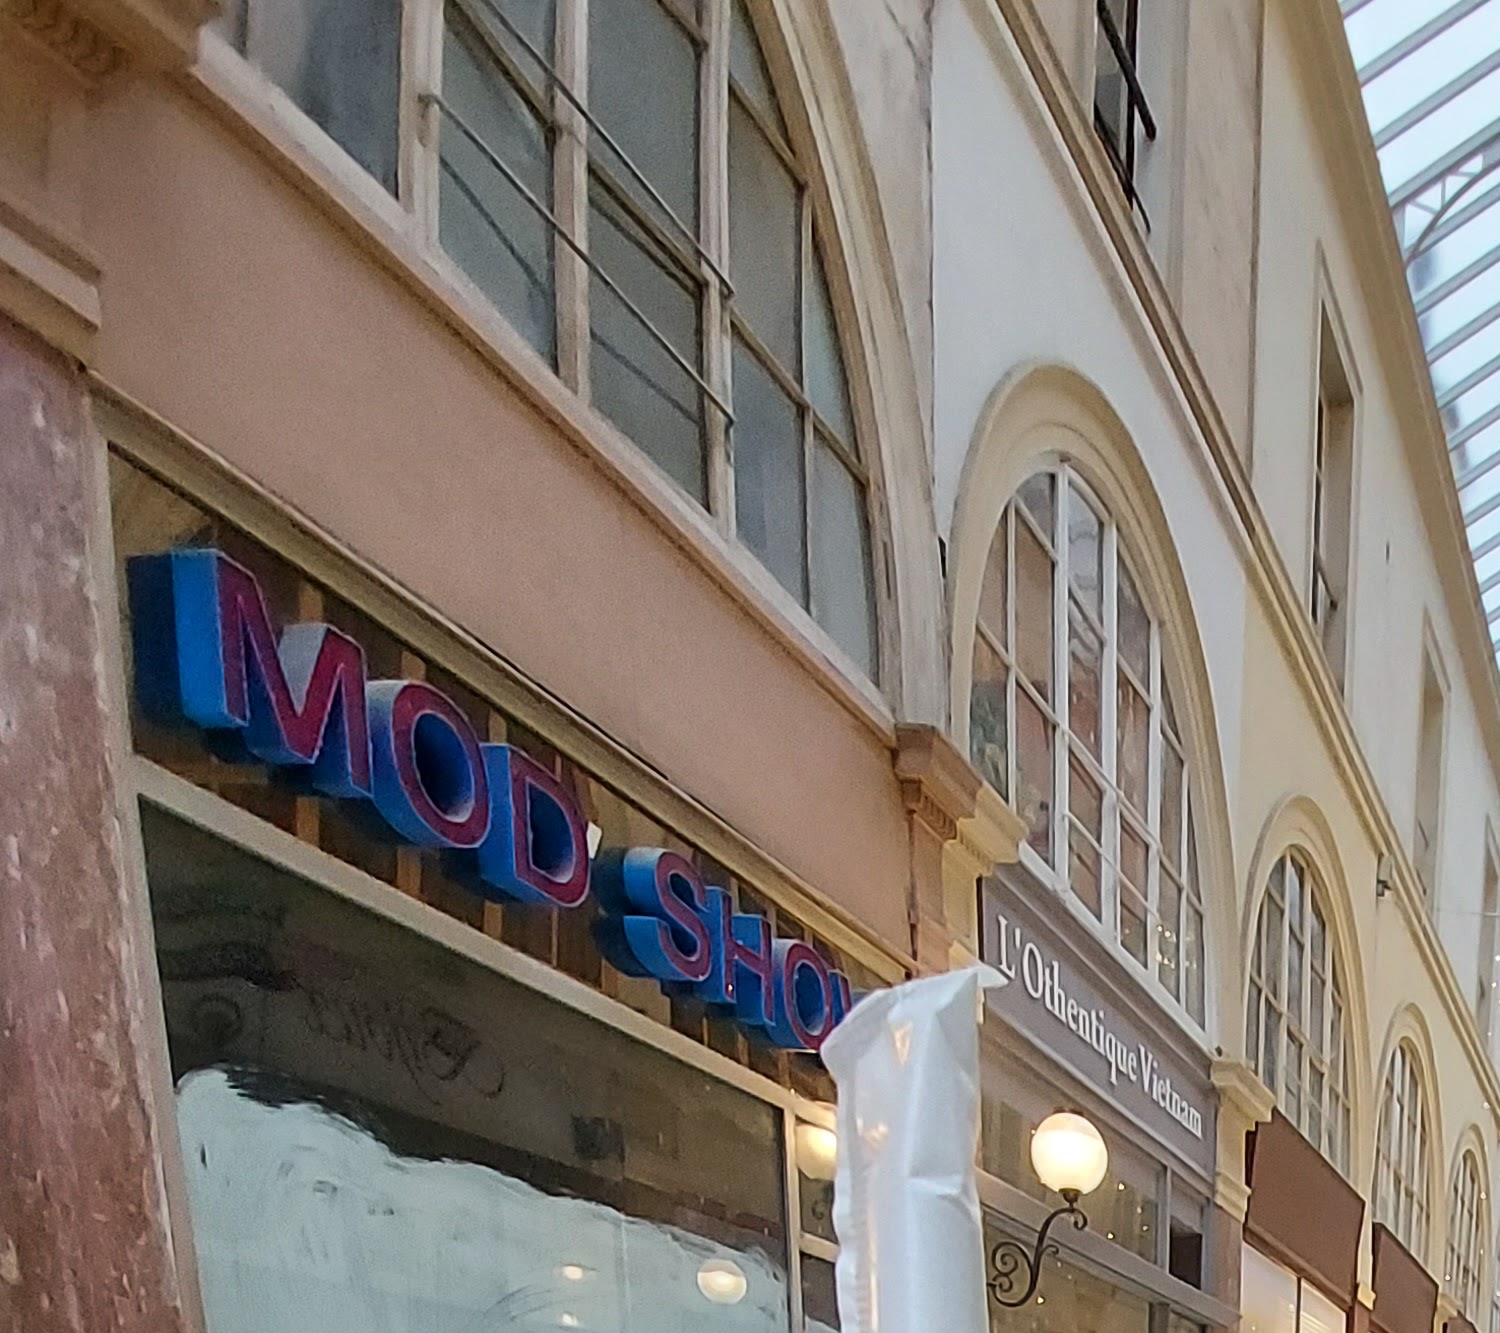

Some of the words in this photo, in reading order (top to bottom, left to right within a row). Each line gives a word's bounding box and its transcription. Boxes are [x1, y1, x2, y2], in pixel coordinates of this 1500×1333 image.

[172, 548, 590, 908] MOD
[622, 846, 852, 1051] SHO
[997, 914, 1138, 1086] L'Othentique
[1138, 1042, 1203, 1140] Vietnam
